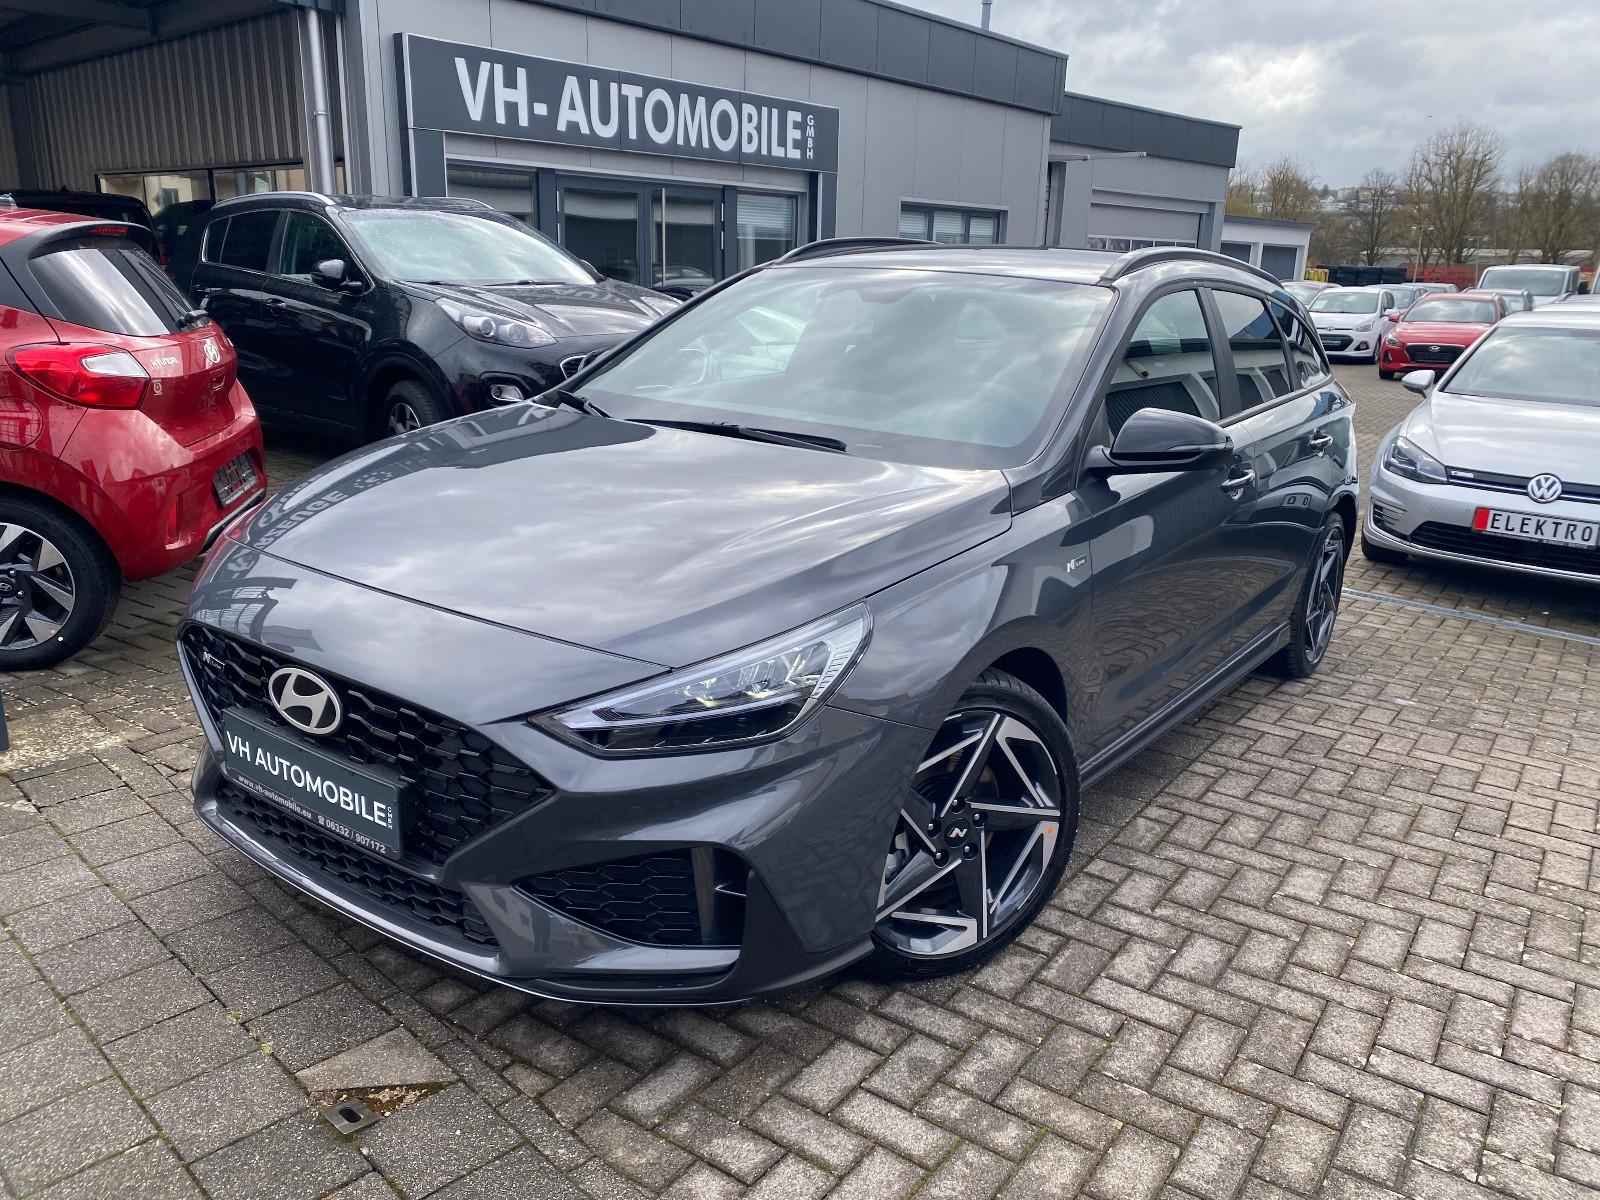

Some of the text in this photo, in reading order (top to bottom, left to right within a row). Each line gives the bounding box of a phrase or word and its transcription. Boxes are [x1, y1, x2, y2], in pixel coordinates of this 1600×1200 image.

[806, 114, 815, 160] GMBH
[1490, 513, 1593, 542] ELEKTRO
[226, 731, 387, 827] VH AUTOMOBILE
[237, 774, 312, 819] www.vh-automobile.eu
[325, 820, 350, 837] 06332
[355, 833, 386, 854] 907172
